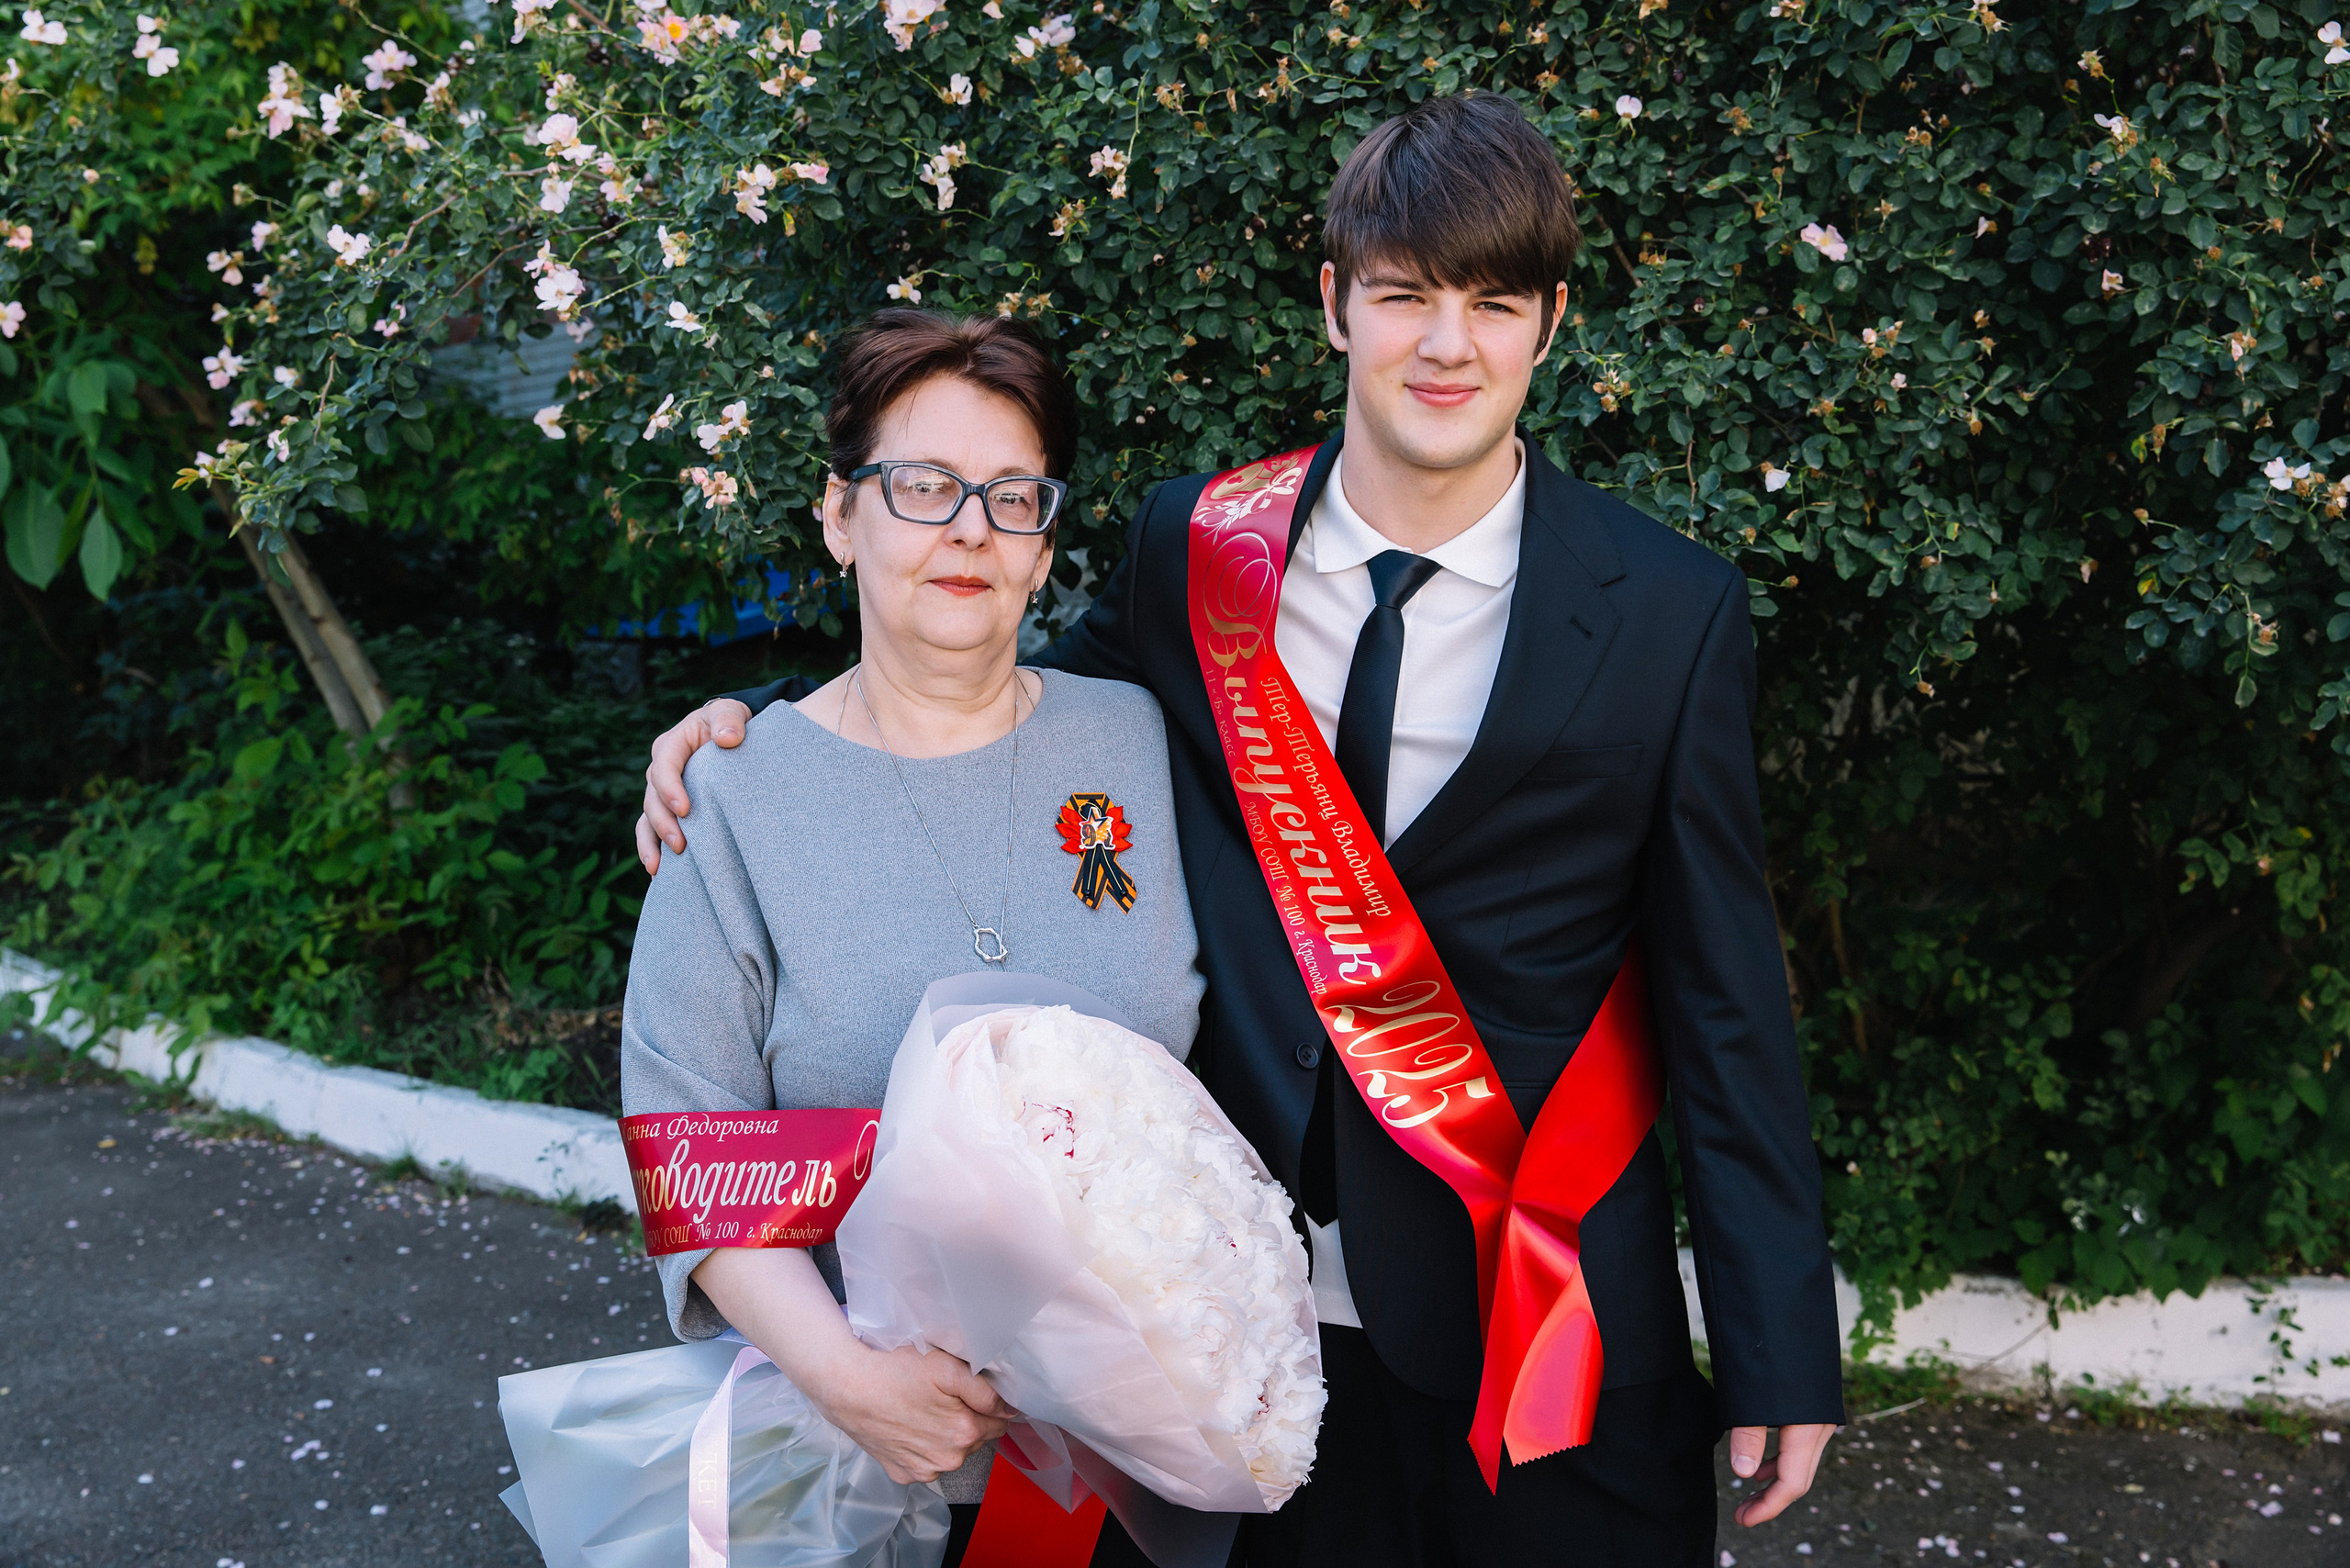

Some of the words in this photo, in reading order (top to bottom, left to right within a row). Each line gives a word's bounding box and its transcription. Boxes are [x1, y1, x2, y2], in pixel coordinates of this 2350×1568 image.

[1203, 532, 1382, 985] Выпускник
[1324, 980, 1495, 1128] 2025
[1206, 669, 1216, 683] 11
[1244, 801, 1272, 847] МБОУ
[1259, 846, 1289, 881] СОШ
[1283, 904, 1305, 926] 100
[1295, 938, 1328, 995] Краснодар
[1331, 820, 1392, 916] Владимир
[666, 1114, 779, 1142] Федоровна
[632, 1138, 837, 1224] ководитель
[714, 1221, 740, 1239] 100
[760, 1222, 823, 1245] Краснодар
